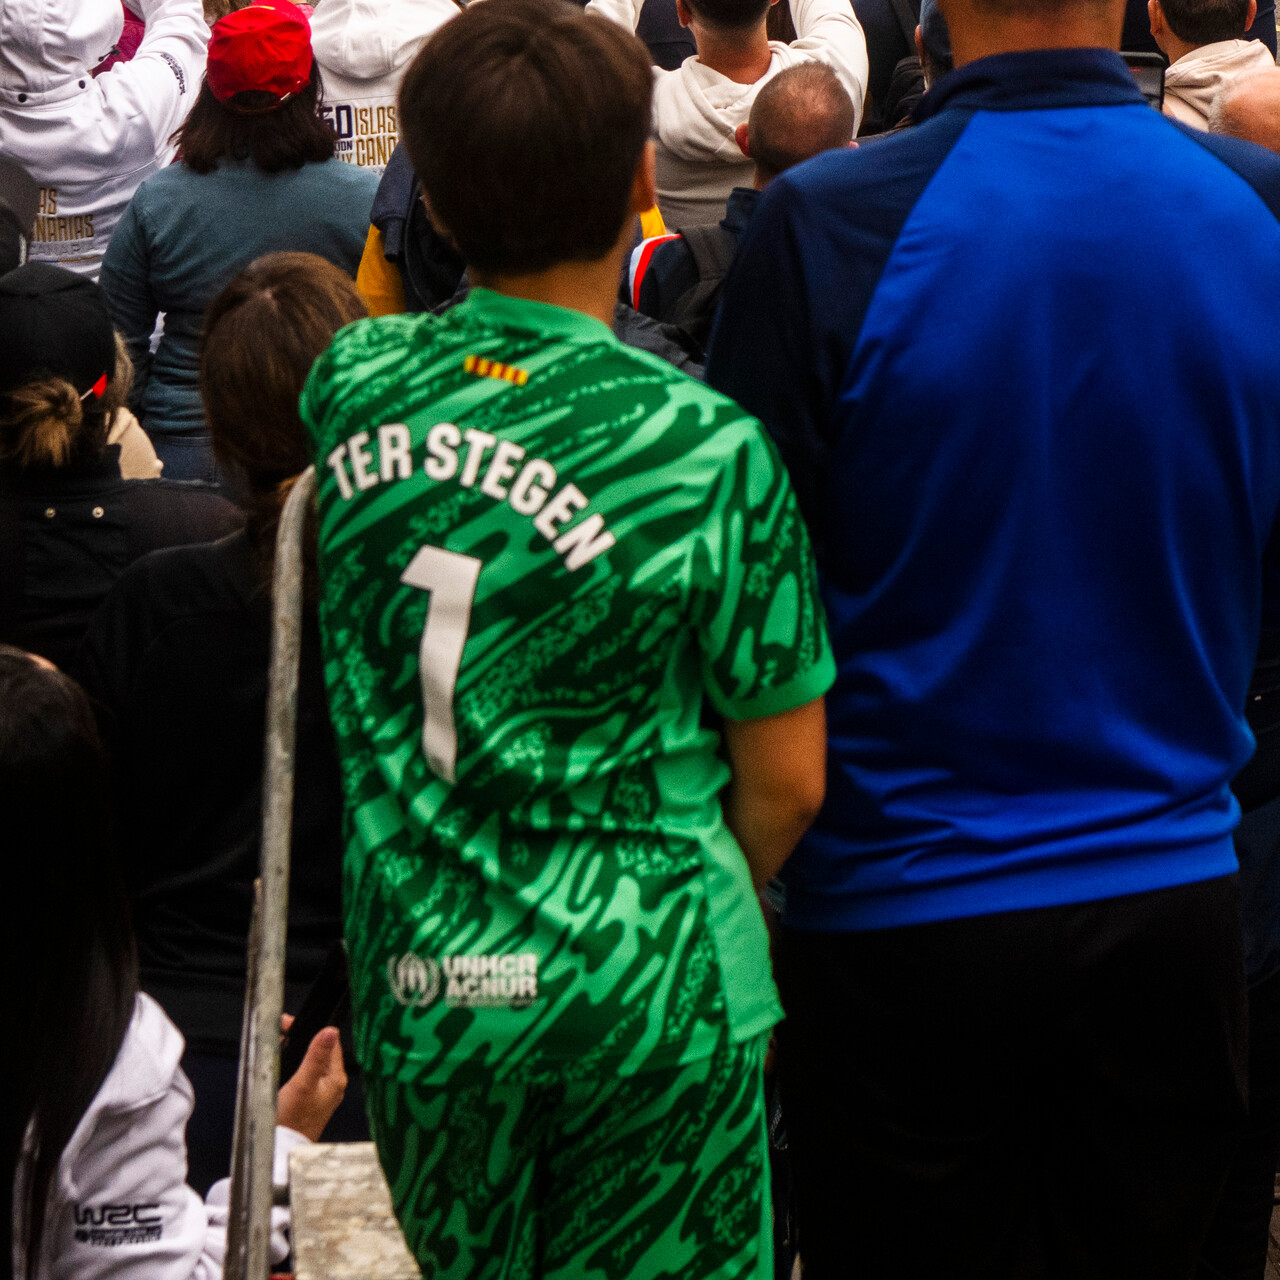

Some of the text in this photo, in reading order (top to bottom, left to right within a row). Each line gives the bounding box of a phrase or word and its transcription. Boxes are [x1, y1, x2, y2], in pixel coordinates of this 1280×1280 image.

[354, 105, 397, 136] ISLAS
[32, 213, 95, 243] NARIAS
[326, 422, 617, 573] TER STEGEN
[399, 543, 484, 788] 1
[442, 952, 539, 978] UNHCR
[445, 974, 539, 999] ACNUR
